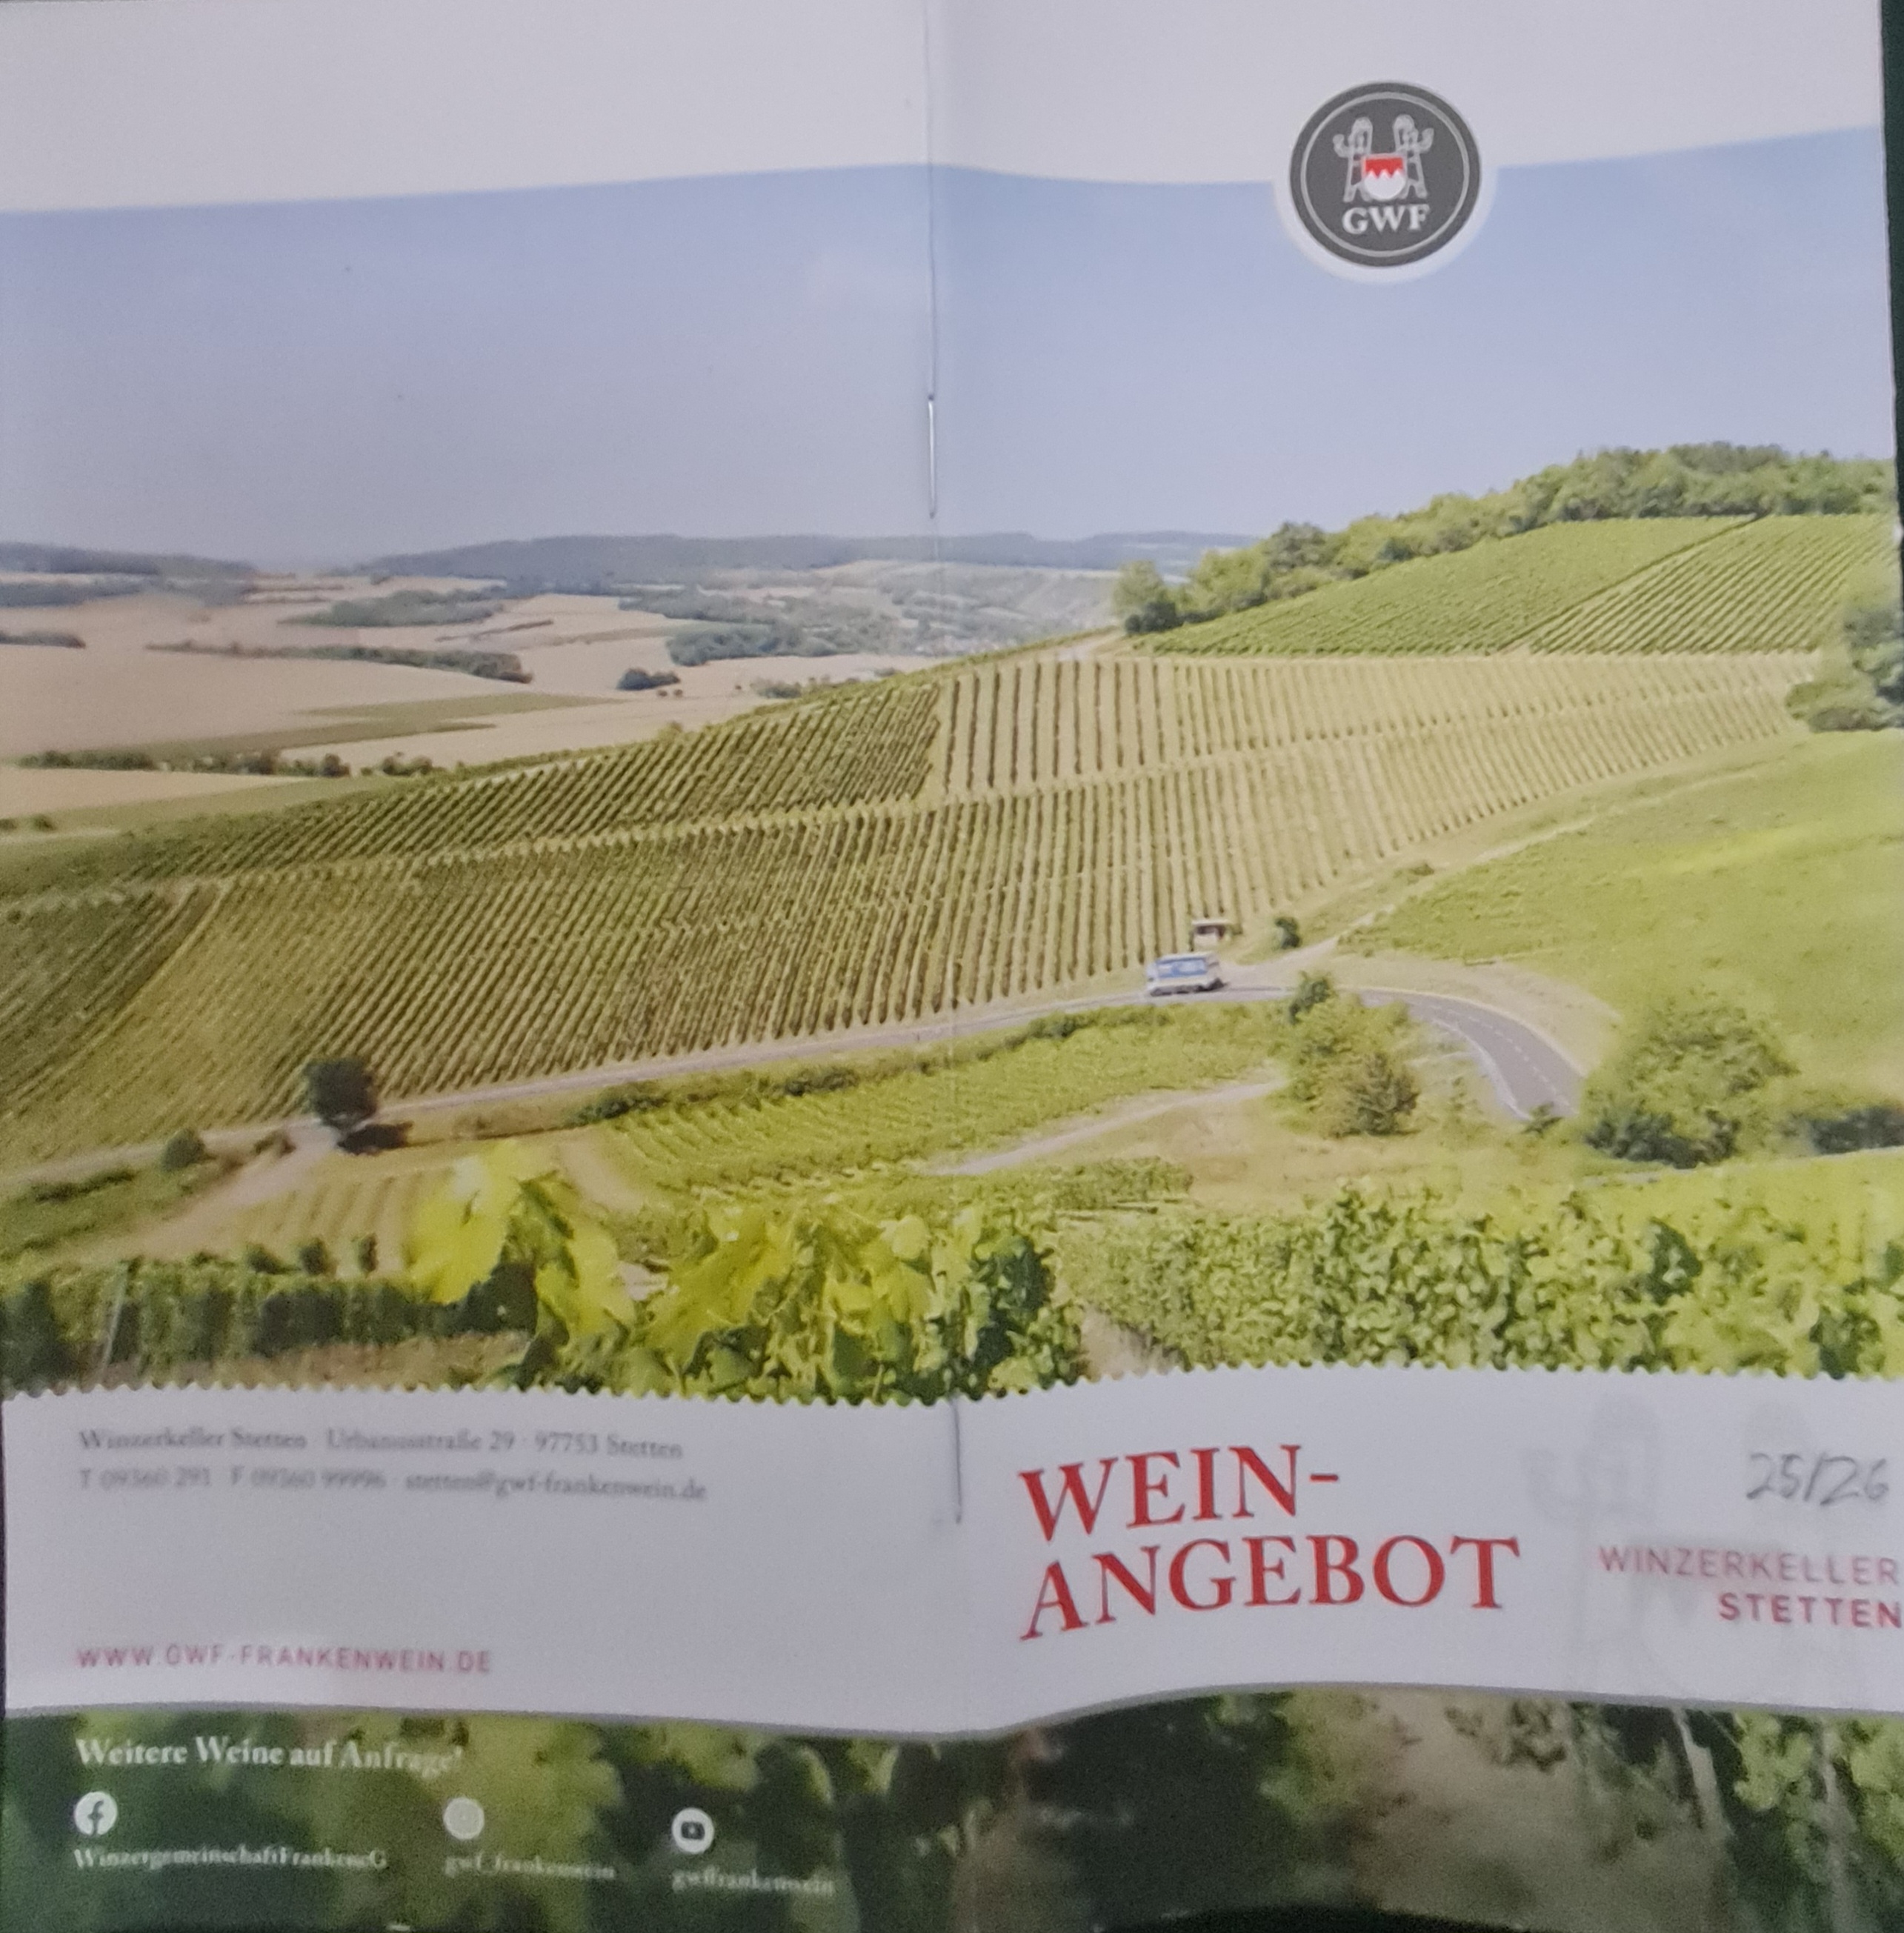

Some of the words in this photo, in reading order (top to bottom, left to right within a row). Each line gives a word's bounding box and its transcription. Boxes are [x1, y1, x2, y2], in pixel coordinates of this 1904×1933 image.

[1342, 204, 1431, 235] GWF
[79, 1427, 224, 1449] Winzerkeller
[231, 1427, 307, 1448] Stetten
[489, 1430, 515, 1451] 29
[535, 1431, 598, 1454] 97753
[607, 1433, 683, 1458] Stetten
[1016, 1445, 1339, 1542] WEIN-
[1746, 1451, 1890, 1506] 25/26
[1597, 1546, 1898, 1586] WINZERKELLER
[1019, 1535, 1521, 1641] ANGEBOT
[1718, 1592, 1902, 1629] STETTEN
[76, 1738, 188, 1766] Weitere
[195, 1734, 284, 1765] Weine
[290, 1740, 339, 1766] auf
